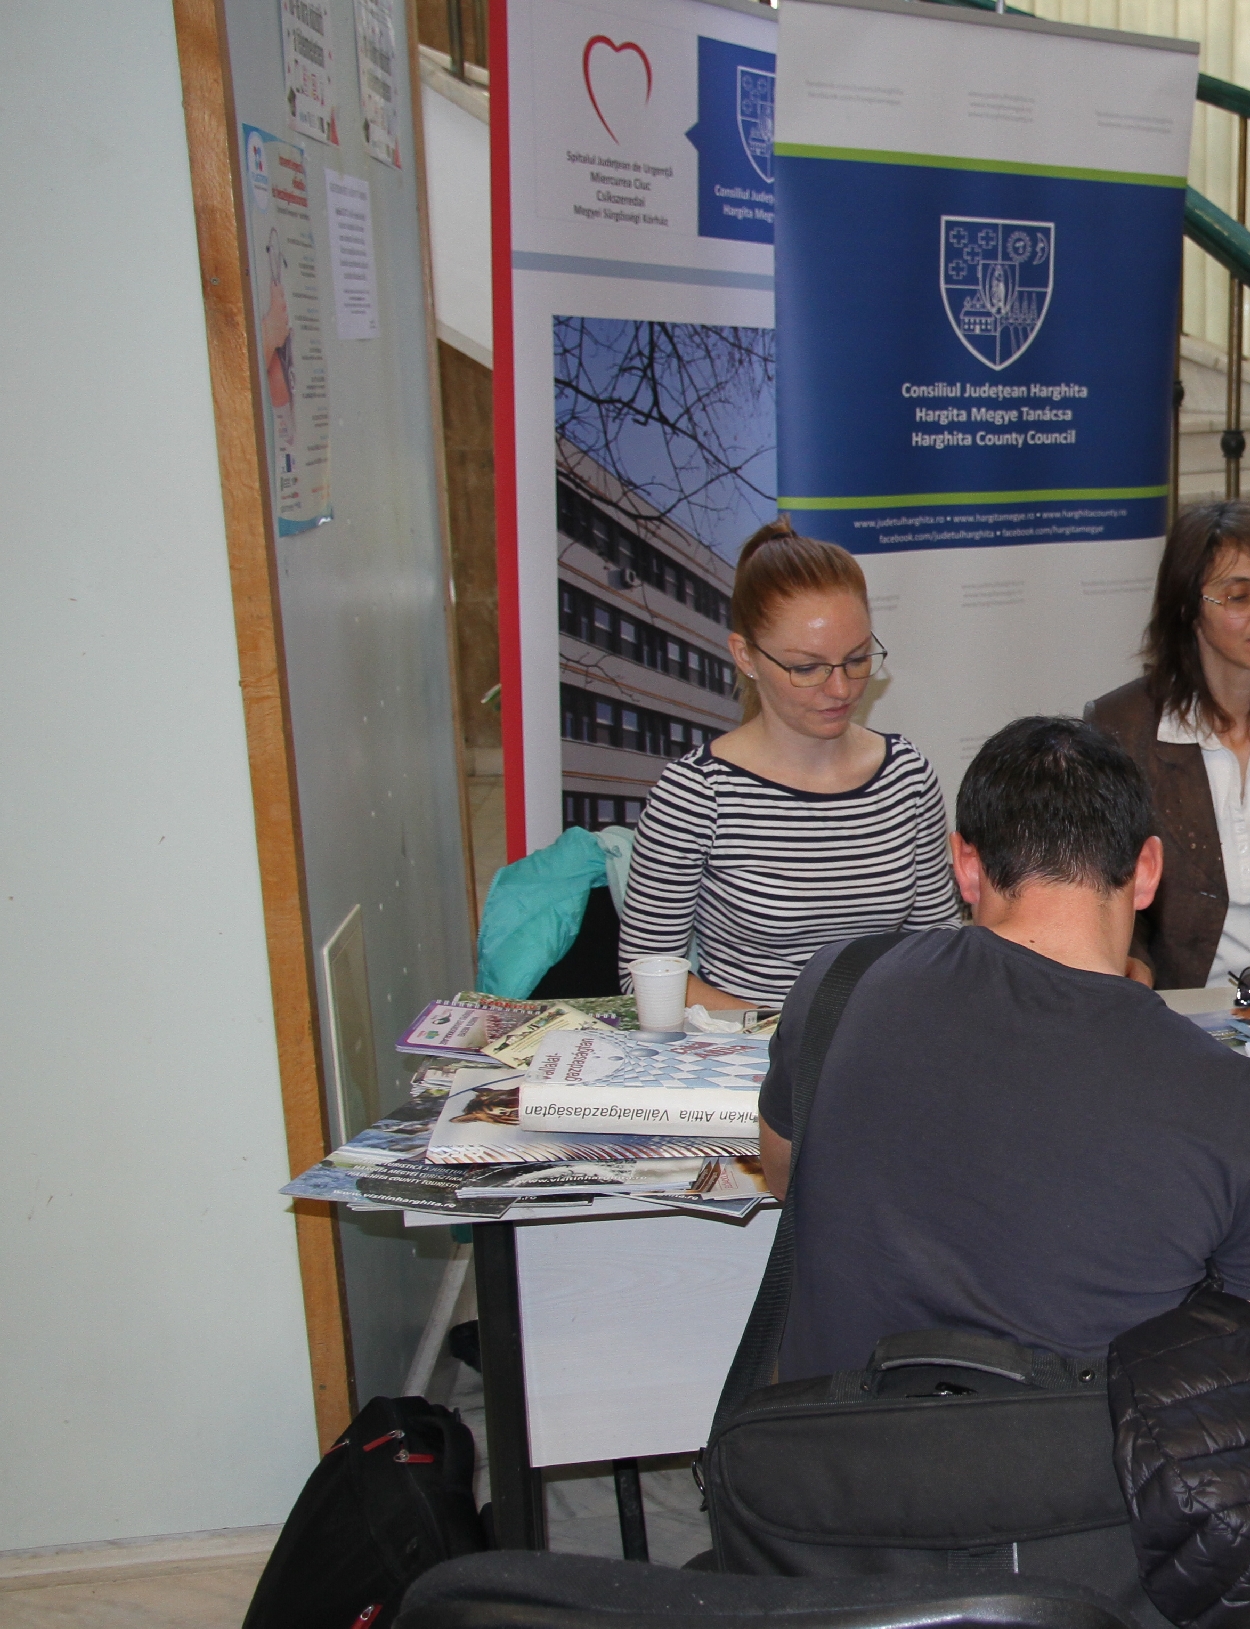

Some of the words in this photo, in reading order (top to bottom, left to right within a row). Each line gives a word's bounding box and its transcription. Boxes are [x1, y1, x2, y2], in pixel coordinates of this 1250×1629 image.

[566, 150, 596, 165] Spitalul
[632, 162, 641, 173] de
[590, 171, 632, 188] Miercurea
[633, 178, 652, 191] Ciuc
[714, 184, 751, 200] Consiliul
[723, 204, 754, 220] Hargita
[902, 382, 961, 398] Consiliul
[1030, 383, 1088, 401] Harghita
[916, 407, 967, 425] Hargita
[971, 407, 1018, 425] Megye
[1021, 405, 1073, 421] Tanácsa
[912, 431, 972, 449] Harghita
[976, 431, 1025, 448] County
[1027, 430, 1076, 445] Council
[854, 515, 945, 529] www.judetulharghita.ro
[953, 512, 1035, 524] www.hargitamegye.ro
[1042, 508, 1127, 520] www.harghitacounty.ro
[879, 530, 994, 544] facebook.com/judetulharghita
[1002, 525, 1104, 538] facebook.com/hargitamegye
[524, 1104, 670, 1122] Vállalatgazdaságtan
[679, 1109, 716, 1122] Attila
